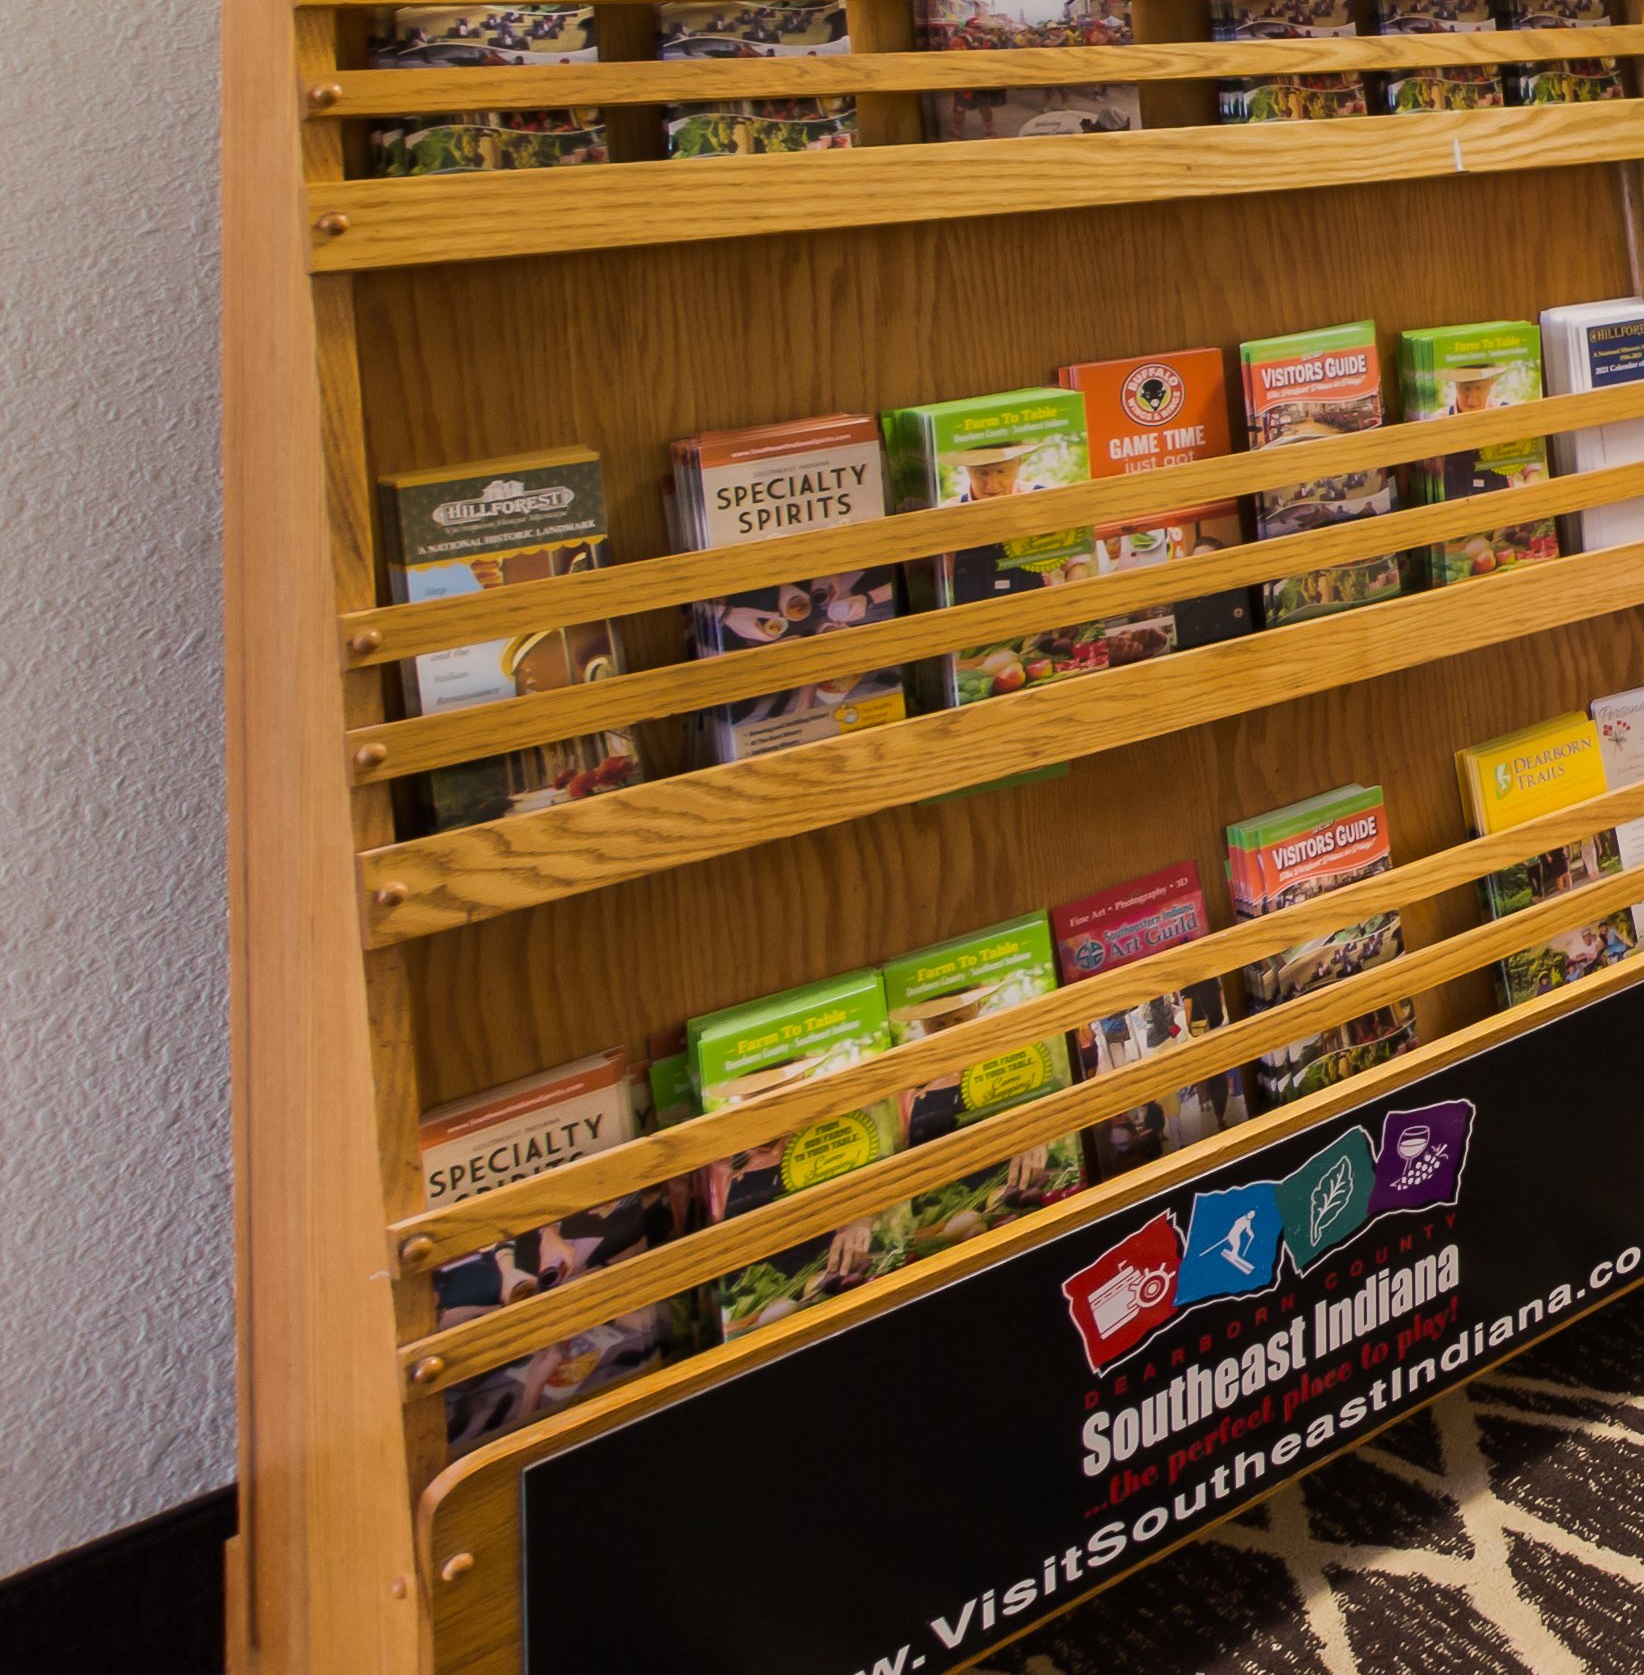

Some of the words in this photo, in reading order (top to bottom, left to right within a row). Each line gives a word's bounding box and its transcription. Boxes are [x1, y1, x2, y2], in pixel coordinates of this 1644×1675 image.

[1260, 355, 1324, 389] VISITORS
[1324, 352, 1367, 380] GUIDE
[964, 417, 1000, 432] Farm
[1002, 413, 1018, 425] To
[1020, 406, 1057, 421] Table
[1109, 433, 1160, 460] GAME
[1163, 426, 1207, 450] TIME
[1124, 457, 1157, 473] just
[449, 492, 562, 520] HILLFOREST
[717, 463, 867, 510] SPECIALTY
[739, 493, 851, 534] SPIRITS
[1513, 736, 1593, 775] DEARBORN
[1514, 763, 1566, 793] TRAILS
[1271, 831, 1335, 870] VISITORS
[1335, 815, 1377, 847] GUIDE
[1069, 914, 1090, 927] Fine
[1090, 908, 1106, 920] Art
[1114, 886, 1167, 911] Photography
[1175, 877, 1188, 889] 3D
[1104, 914, 1162, 942] Southeastern
[1162, 902, 1194, 919] Indiana
[1109, 937, 1141, 963] Art
[1144, 911, 1200, 946] Guild
[916, 961, 955, 982] Farm
[958, 954, 977, 968] To
[979, 941, 1019, 962] Table
[738, 1033, 778, 1055] Farm
[781, 1024, 802, 1039] To
[804, 1009, 847, 1032] Table
[429, 1113, 605, 1198] SPECIALTY
[1083, 1295, 1297, 1410] DEARBORN
[1324, 1212, 1458, 1290] COUNTY
[1083, 1315, 1307, 1477] Southeast
[1313, 1243, 1460, 1359] Indiana
[1166, 1397, 1276, 1485] perfect
[1282, 1361, 1353, 1423] place
[1361, 1338, 1389, 1372] to
[1397, 1294, 1460, 1362] play!
